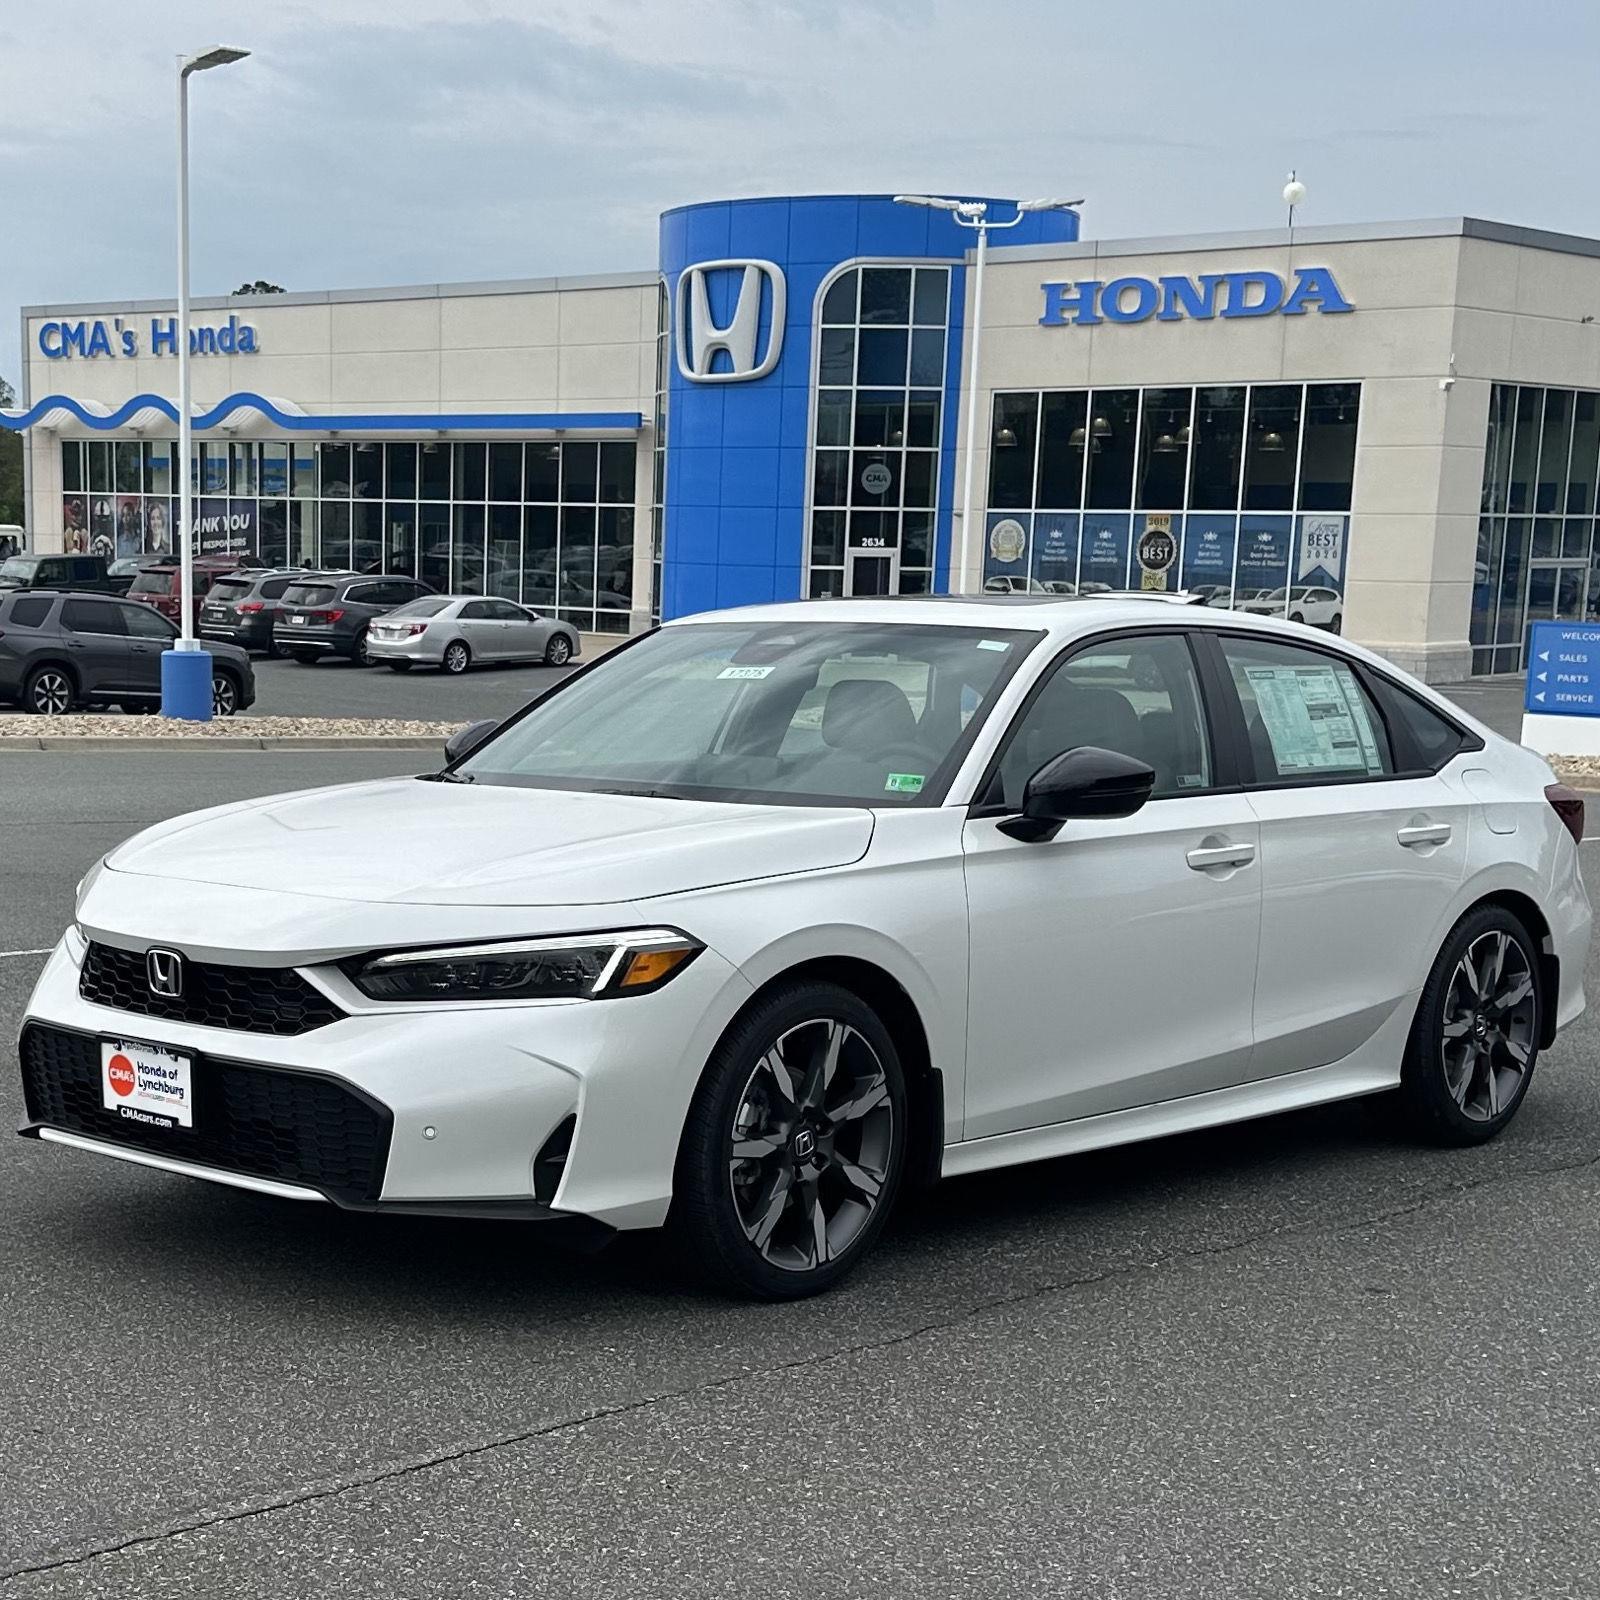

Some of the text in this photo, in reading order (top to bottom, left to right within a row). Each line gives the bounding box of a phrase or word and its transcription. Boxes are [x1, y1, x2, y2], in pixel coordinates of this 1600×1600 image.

[1039, 267, 1354, 326] HONDA
[39, 317, 138, 359] CMA's
[222, 513, 250, 531] YOU
[861, 537, 885, 547] 2634
[1308, 534, 1338, 546] BEST
[1143, 547, 1170, 560] BEST
[1307, 550, 1338, 559] 2020
[1559, 653, 1588, 663] SALES
[1557, 673, 1589, 683] PARTS
[1555, 693, 1594, 703] SERVICE
[137, 1061, 178, 1080] Honda of
[138, 1076, 184, 1100] Lynchburg
[120, 1107, 172, 1128] CMAcars.com
